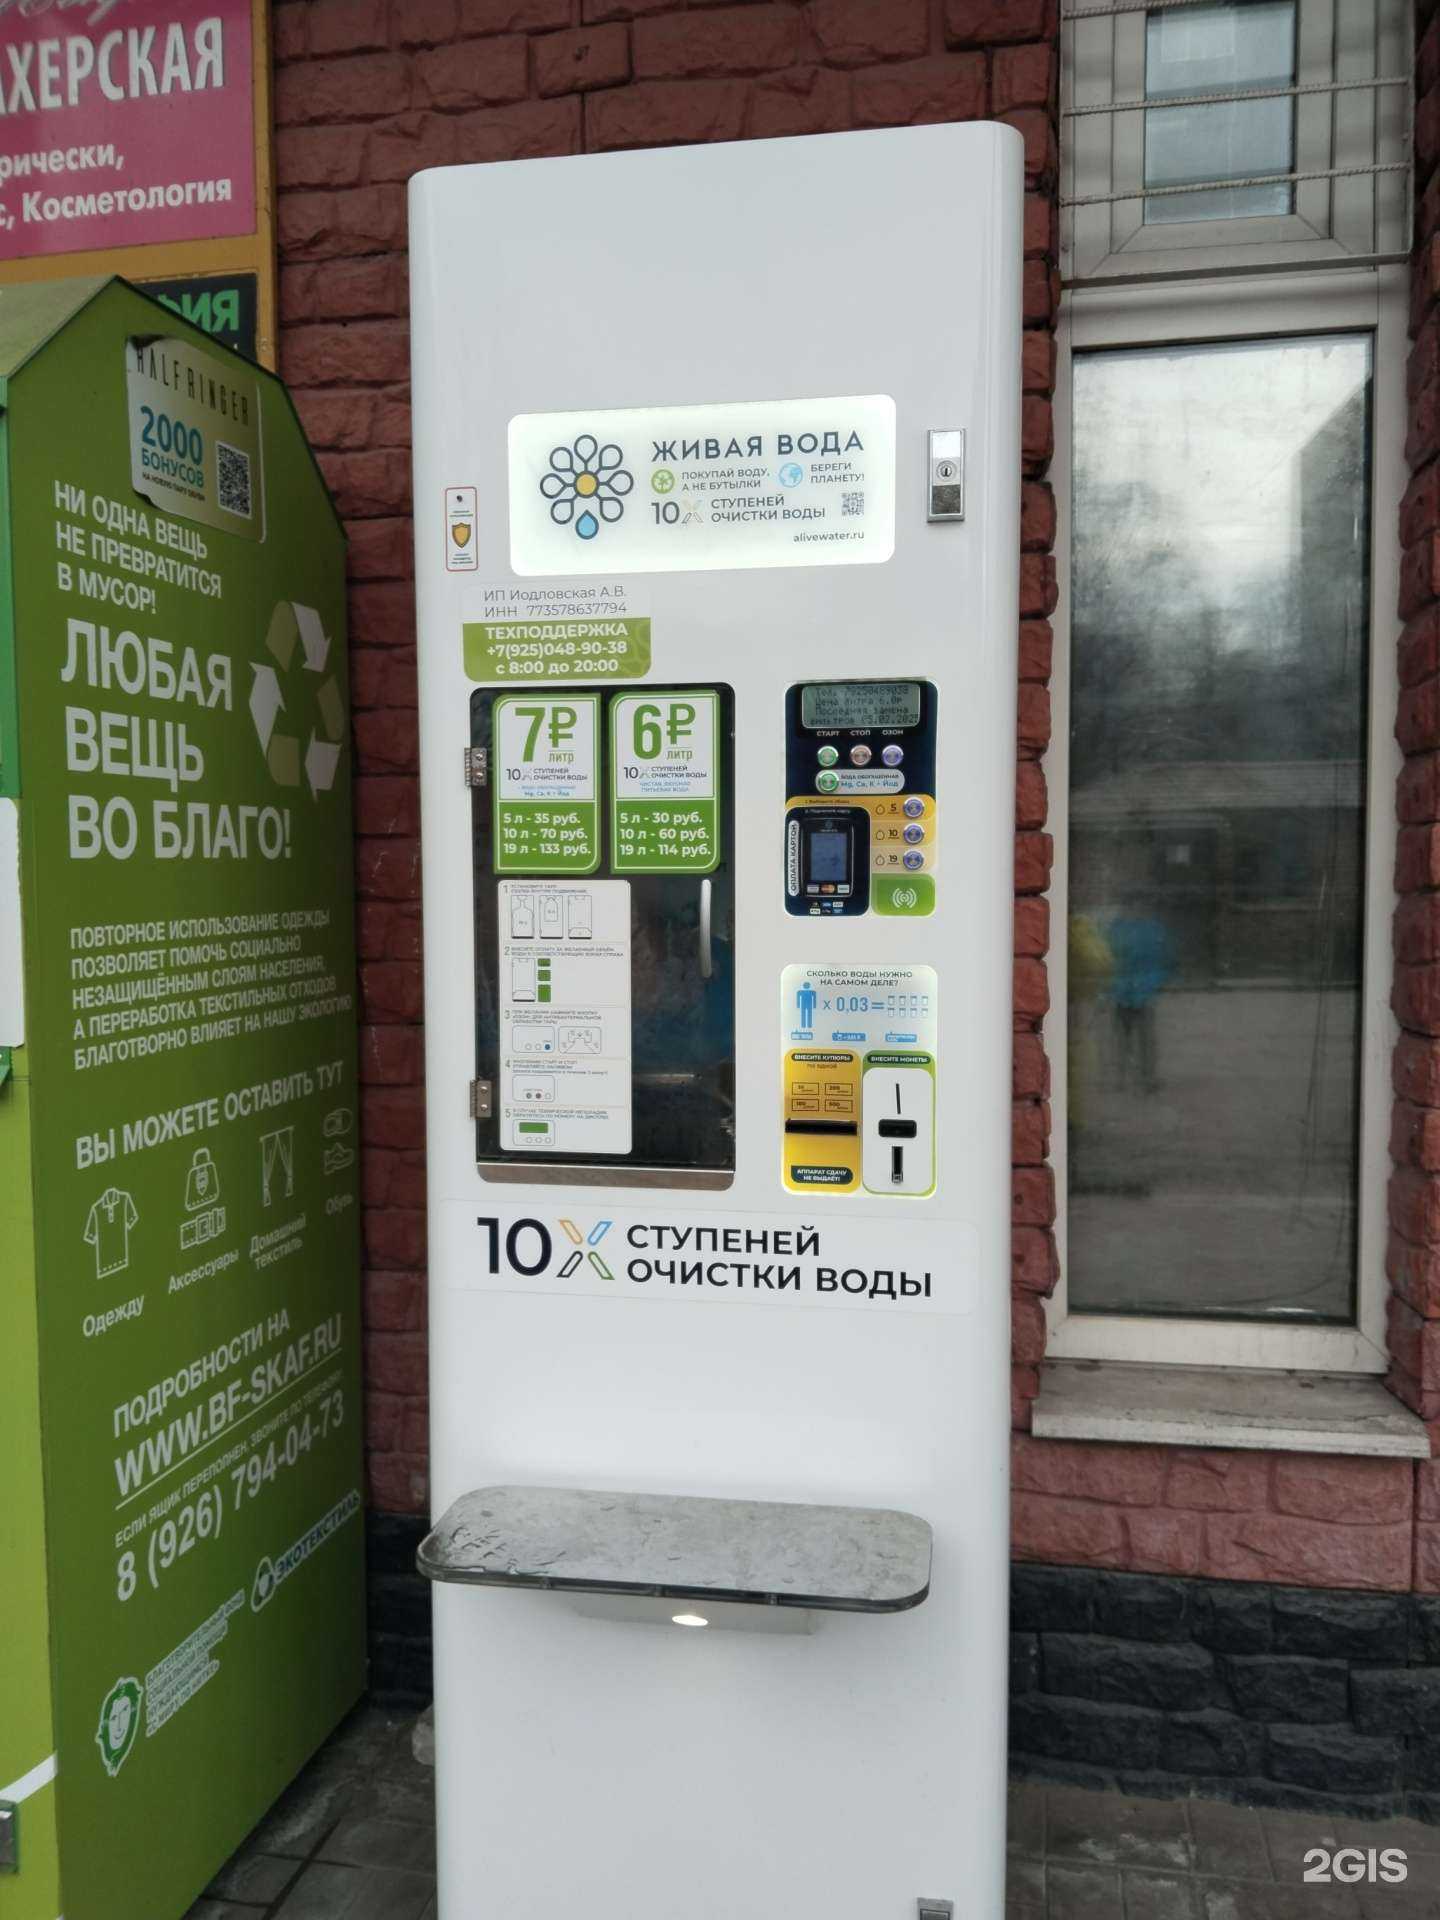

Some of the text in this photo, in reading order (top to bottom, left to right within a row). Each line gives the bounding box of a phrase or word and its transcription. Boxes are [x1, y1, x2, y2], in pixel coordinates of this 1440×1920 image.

[0, 17, 224, 116] ХЕРСКАЯ
[22, 178, 232, 223] Косметология
[158, 289, 240, 333] ИЯ
[136, 345, 249, 426] HALFRINGER
[141, 405, 203, 466] 2000
[651, 429, 864, 462] ЖИВАЯ ВОДА
[141, 447, 204, 488] БОНУСОВ
[681, 468, 735, 480] ПОКУПАЙ
[810, 462, 852, 473] БЕРЕГИ
[810, 473, 864, 485] ПЛАНЕТУ!
[681, 480, 761, 492] А НЕ БУТЫЛКИ
[711, 493, 785, 510] СТУПЕНЕЙ
[55, 480, 208, 560] НИ ОДНА ВЕЩЬ
[711, 507, 826, 523] ОЧИСТКИ ВОДЫ
[793, 531, 865, 543] alivewater.ru
[56, 521, 222, 599] НЕ ПРЕВРАТИТСЯ
[57, 561, 157, 614] В МУСОР!
[484, 590, 506, 602] ИП
[600, 585, 627, 598] А.В.
[484, 602, 627, 618] ИНН 773578637794
[485, 622, 629, 641] ТЕХПОДДЕРЖКА
[487, 641, 628, 660] +7(925)048-90-38
[61, 618, 233, 711] ЛЮБАЯ
[496, 659, 618, 675] с 8:00 до 20:00
[65, 705, 204, 792] ВЕЩЬ
[548, 752, 575, 764] литр
[666, 749, 693, 761] литр
[533, 767, 569, 775] СТУПЕНЕЙ
[567, 774, 588, 782] ВОДЫ
[651, 765, 688, 773] СТУПЕНЕЙ
[686, 772, 707, 780] ВОДЫ
[68, 794, 292, 860] ВО БЛАГО!
[503, 813, 581, 826] 5 л 35 руб.
[620, 812, 702, 825] 5 л 30 руб.
[503, 828, 588, 841] 10 л 70 руб.
[620, 828, 709, 842] 10 л 60 руб.
[790, 824, 798, 858] КАРТОЙ
[889, 829, 898, 837] 10
[503, 844, 591, 857] 19 л 133 руб.
[620, 844, 711, 858] 19 л 114 руб.
[889, 855, 898, 863] 19
[70, 909, 330, 950] ПОВТОРНОЕ ИСПОЛЬЗОВАНИЕ ОДЕЖДЫ
[71, 935, 301, 980] ПОЗВОЛЯЕТ ПОМОЧЬ СОЦИАЛЬНО
[72, 971, 208, 1010] НЕЗАЩИЩЁННЫМ
[212, 965, 257, 988] СЛОЯМ
[806, 970, 913, 979] СКОЛЬКО ВОДЫ НУЖНО
[870, 979, 899, 987] ДЕЛЕ?
[73, 975, 337, 1040] А ПЕРЕРАБОТКА ТЕКСТИЛЬНЫХ ОТХОДОВ
[74, 1028, 187, 1071] БЛАГОТВОРНО
[190, 1017, 242, 1045] ВЛИЯЕТ
[244, 1013, 261, 1033] НА
[263, 1006, 298, 1028] НАШУ
[76, 1059, 344, 1170] ВЫ МОЖЕТЕ ОСТАВИТЬ ТУТ
[627, 1223, 820, 1257] СТУПЕНЕЙ
[168, 1249, 240, 1294] Аксессуары
[627, 1257, 932, 1300] ОЧИСТКИ ВОДЫ
[82, 1295, 145, 1338] Одежду
[113, 1308, 290, 1438] ПОДРОБНОСТИ НА
[114, 1312, 342, 1497] WWW.BF-SKAF.RU
[117, 1389, 344, 1601] 8 (926) 794-04-73
[115, 1513, 147, 1549] ЕСЛИ
[148, 1487, 183, 1524] ЯЩИК
